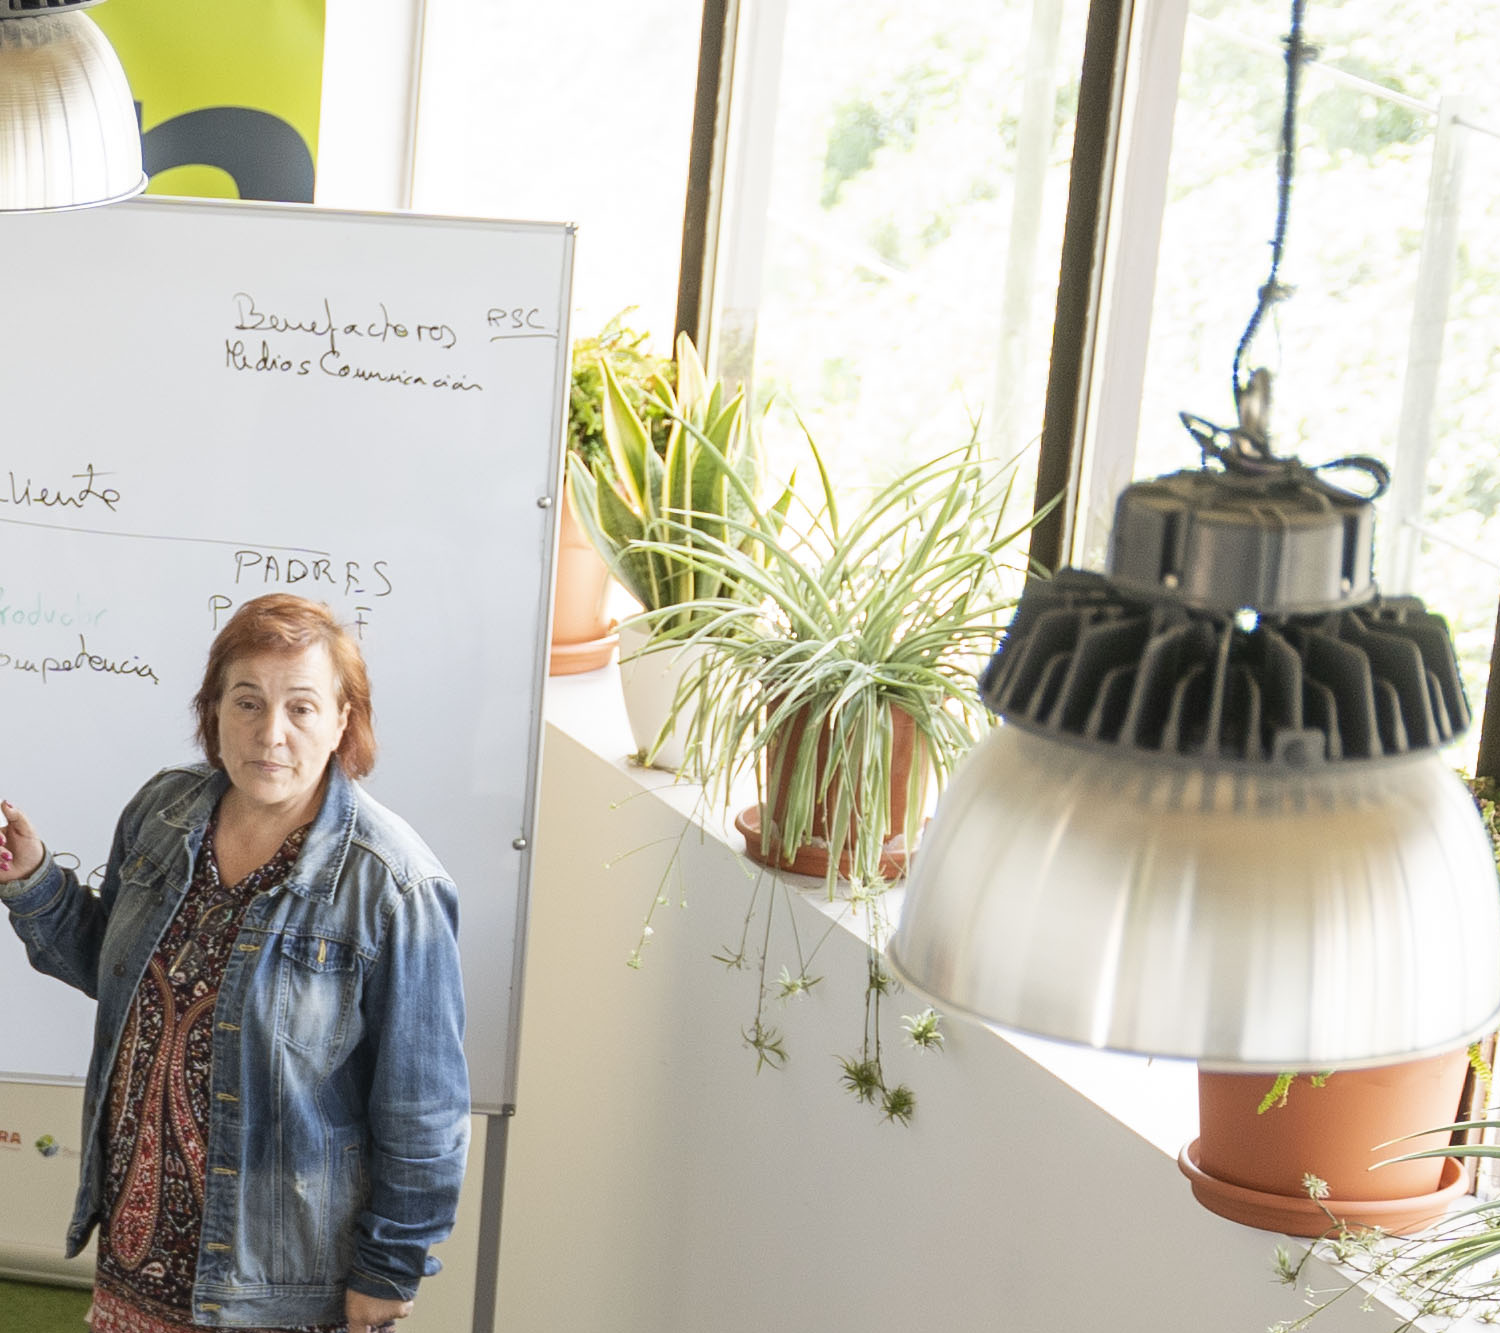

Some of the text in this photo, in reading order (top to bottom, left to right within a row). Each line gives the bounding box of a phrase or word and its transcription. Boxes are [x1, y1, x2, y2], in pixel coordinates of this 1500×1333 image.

[232, 292, 545, 351] Benefactores RSC
[225, 339, 311, 375] Medios
[234, 550, 393, 597] PADRES
